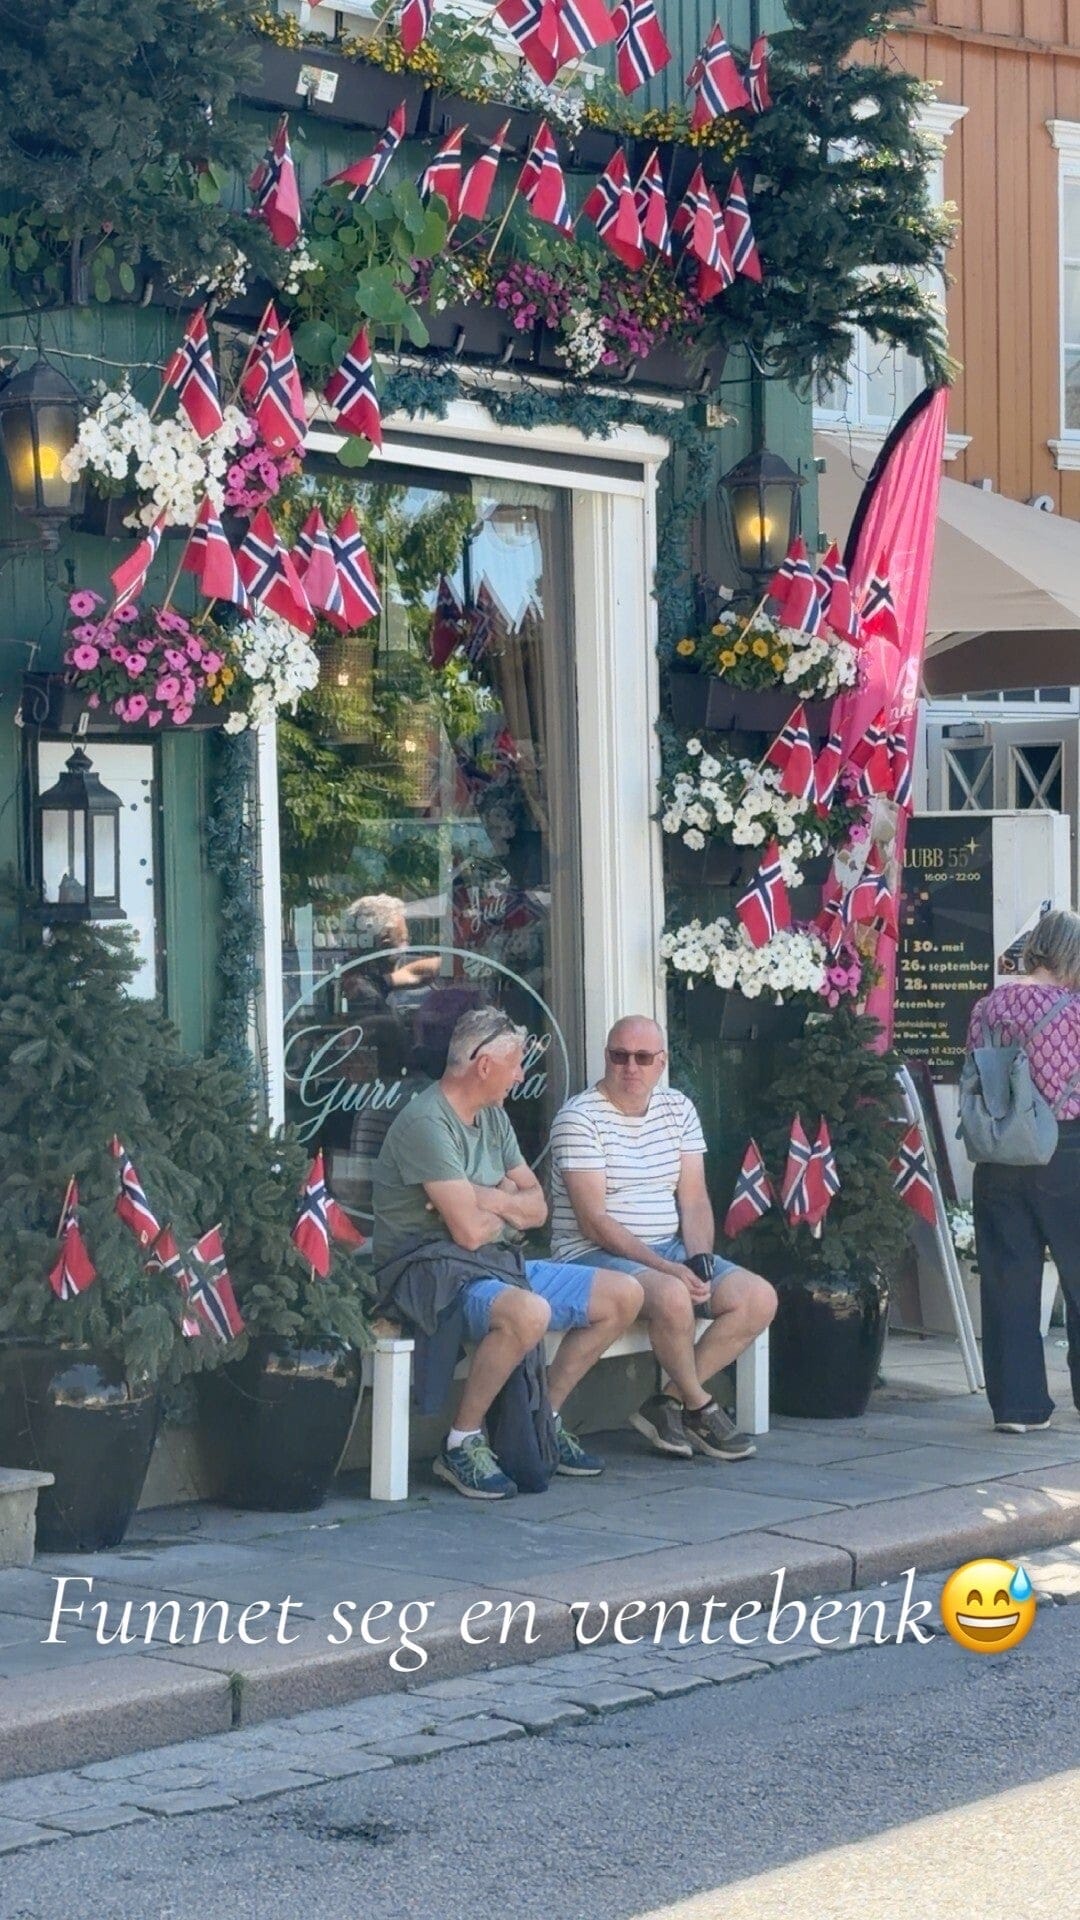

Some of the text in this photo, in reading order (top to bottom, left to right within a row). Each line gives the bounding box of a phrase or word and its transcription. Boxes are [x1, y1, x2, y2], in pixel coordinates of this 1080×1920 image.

[903, 848, 944, 868] LUBB
[924, 873, 948, 881] 16:00
[955, 872, 981, 881] 22:00
[913, 940, 939, 952] 30.
[941, 942, 964, 952] mai
[901, 959, 990, 973] 26. september
[904, 978, 928, 990] 28.
[930, 981, 988, 990] november
[893, 999, 946, 1009] desember
[283, 1025, 407, 1143] Guri
